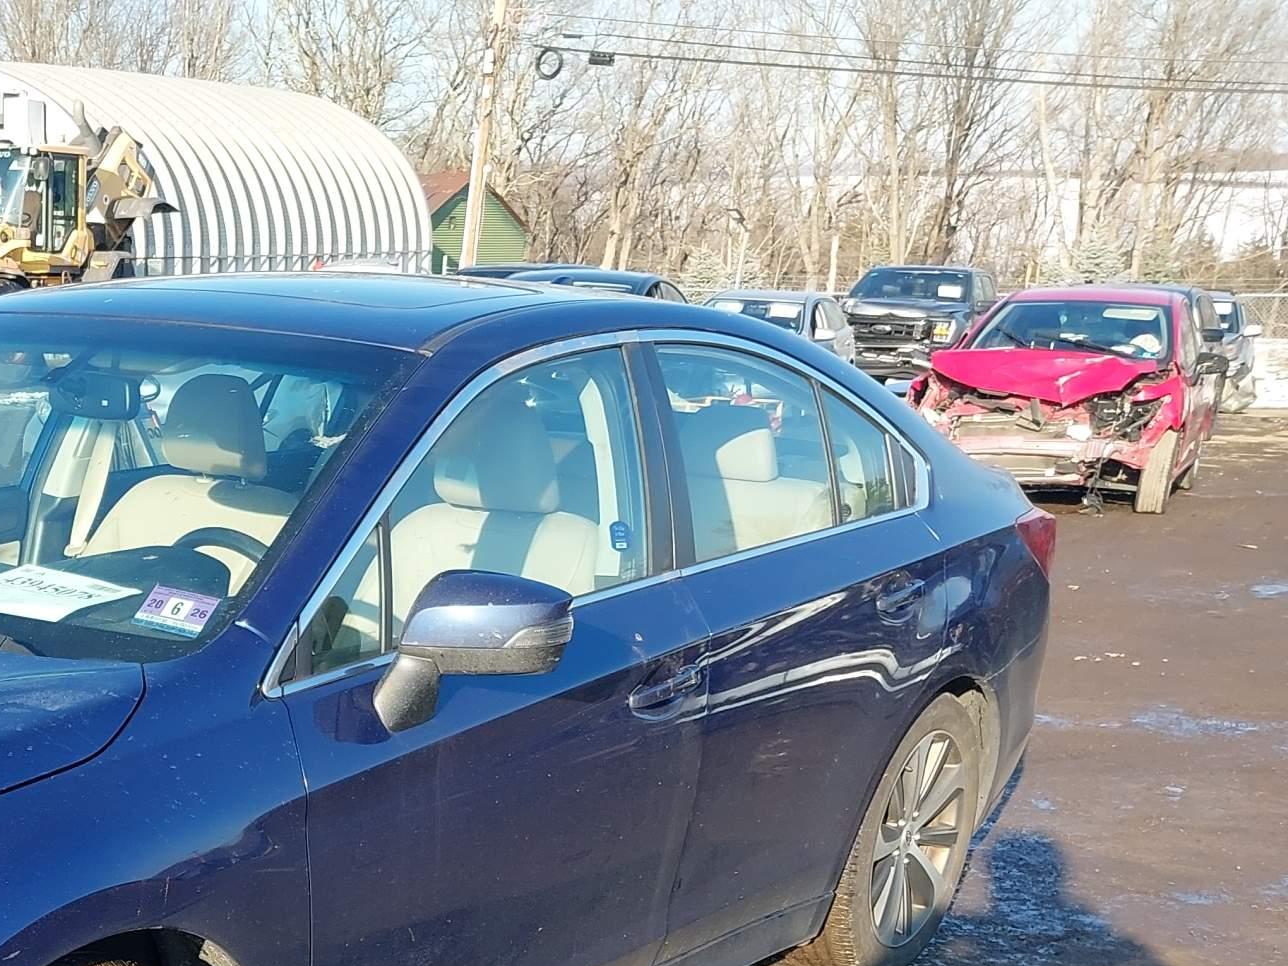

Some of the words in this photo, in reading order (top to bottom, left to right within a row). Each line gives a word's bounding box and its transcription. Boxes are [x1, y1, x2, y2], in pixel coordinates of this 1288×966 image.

[146, 598, 164, 609] 20
[170, 601, 185, 616] 6
[190, 607, 209, 619] 26
